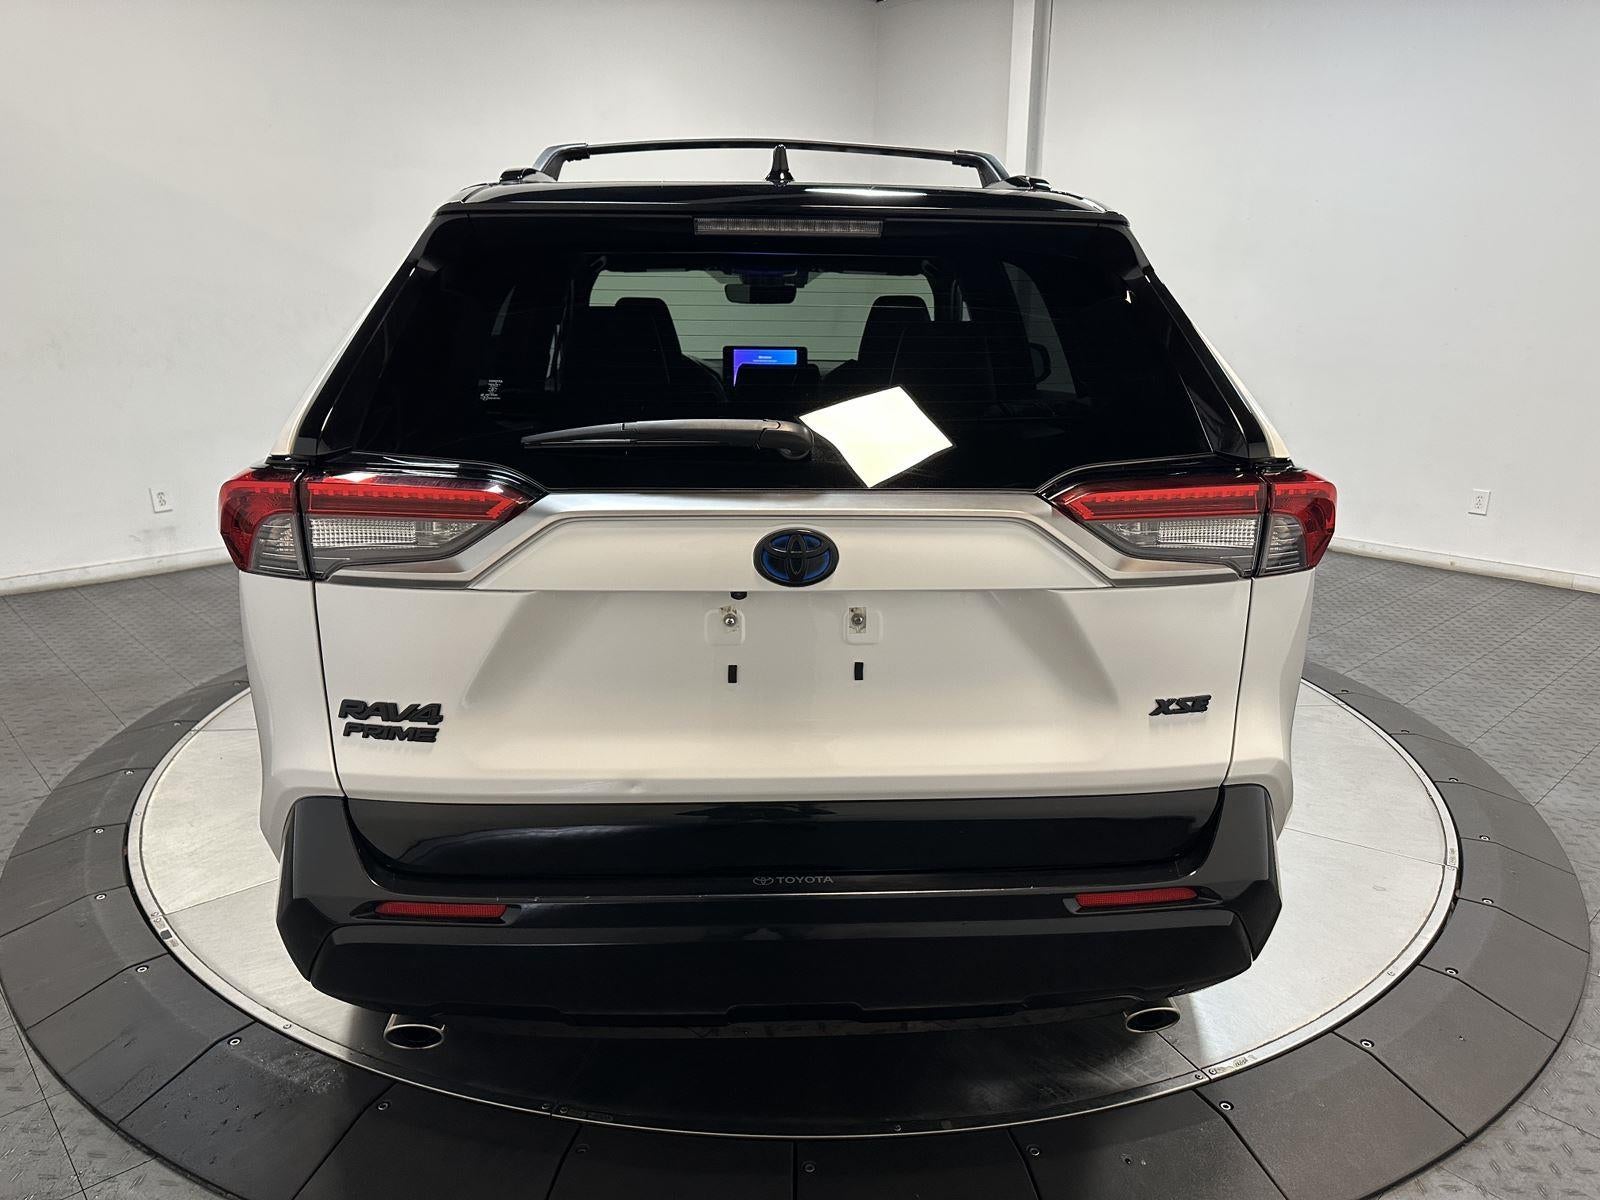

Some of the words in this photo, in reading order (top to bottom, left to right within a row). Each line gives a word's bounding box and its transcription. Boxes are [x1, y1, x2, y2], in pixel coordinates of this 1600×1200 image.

[338, 699, 444, 725] RAV4
[1148, 694, 1212, 716] XSE
[342, 722, 440, 743] PRIME
[776, 876, 834, 884] TOYOTA
